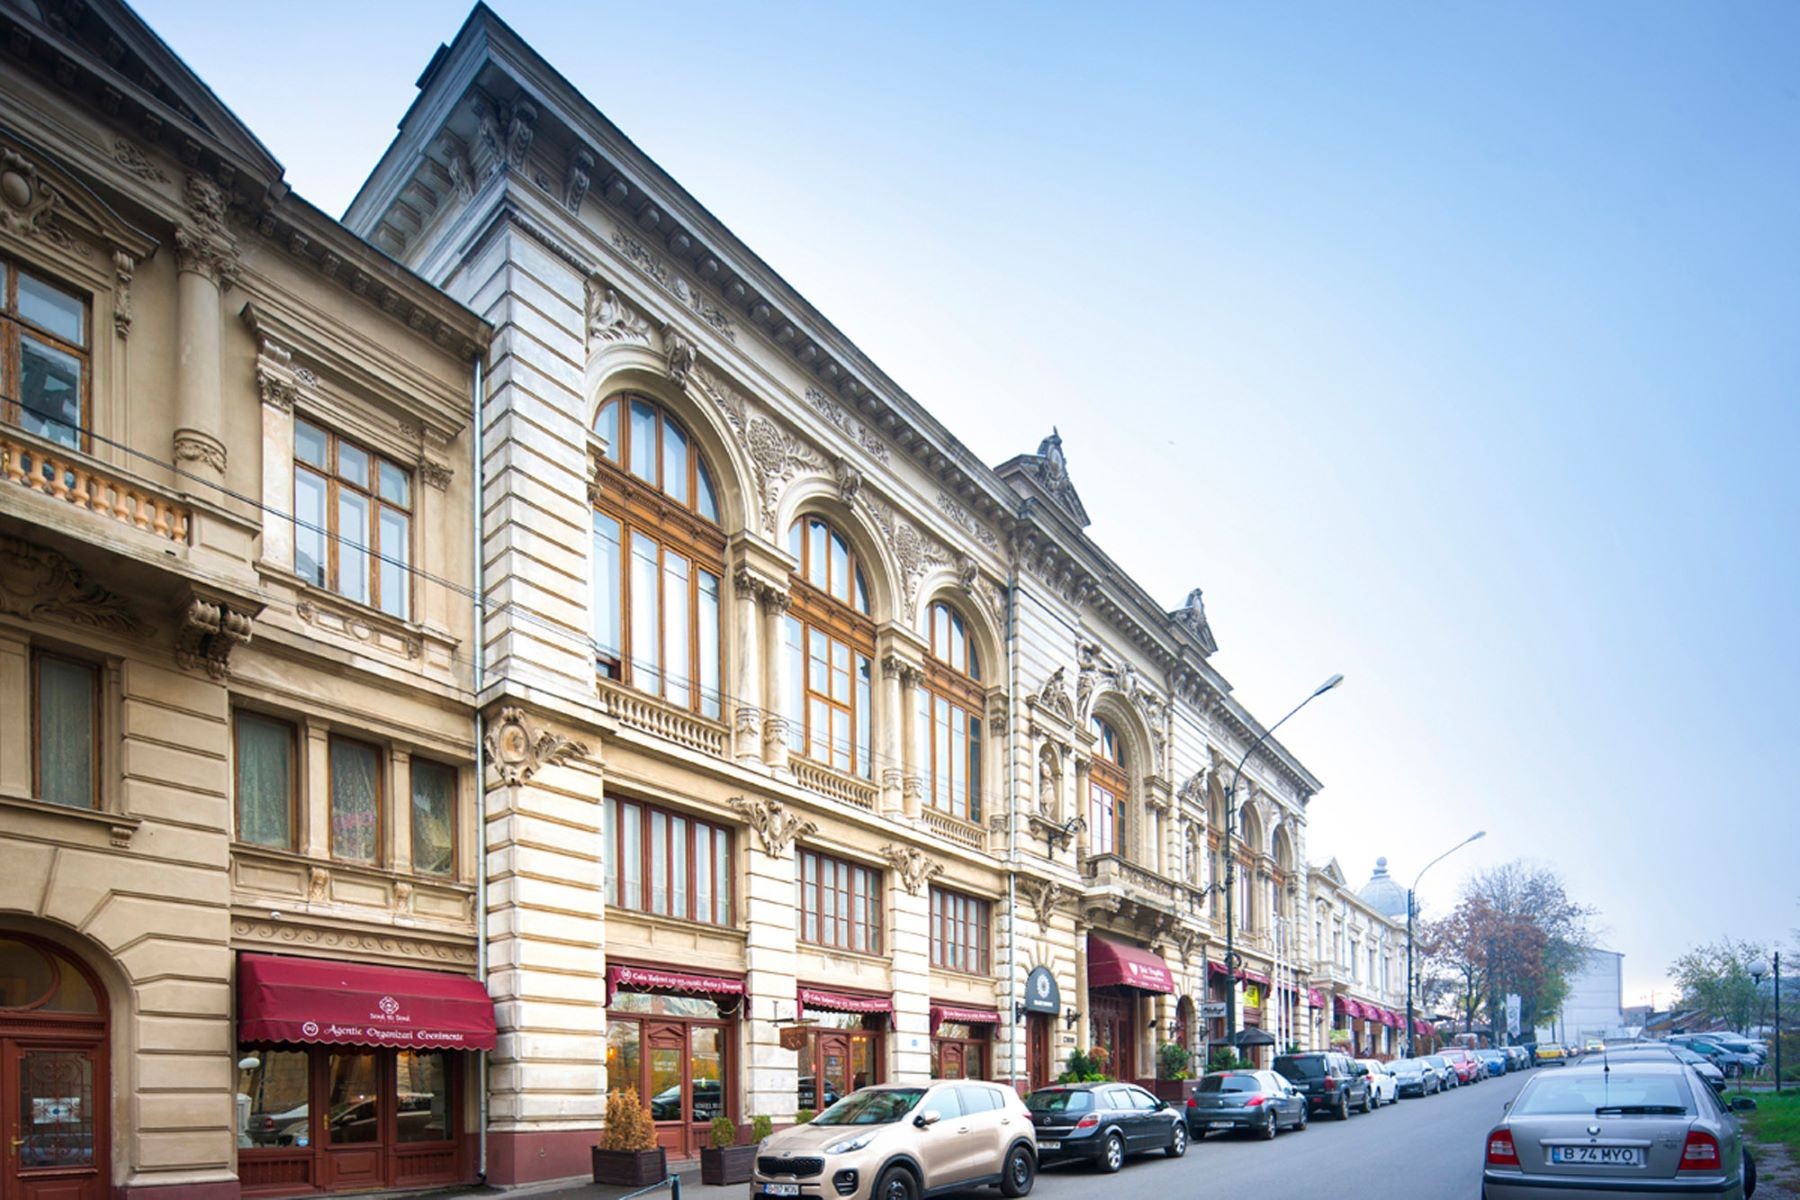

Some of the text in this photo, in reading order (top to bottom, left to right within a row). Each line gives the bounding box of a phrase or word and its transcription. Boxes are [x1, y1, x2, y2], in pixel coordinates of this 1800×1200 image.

[1564, 1148, 1633, 1161] B 74 MYO
